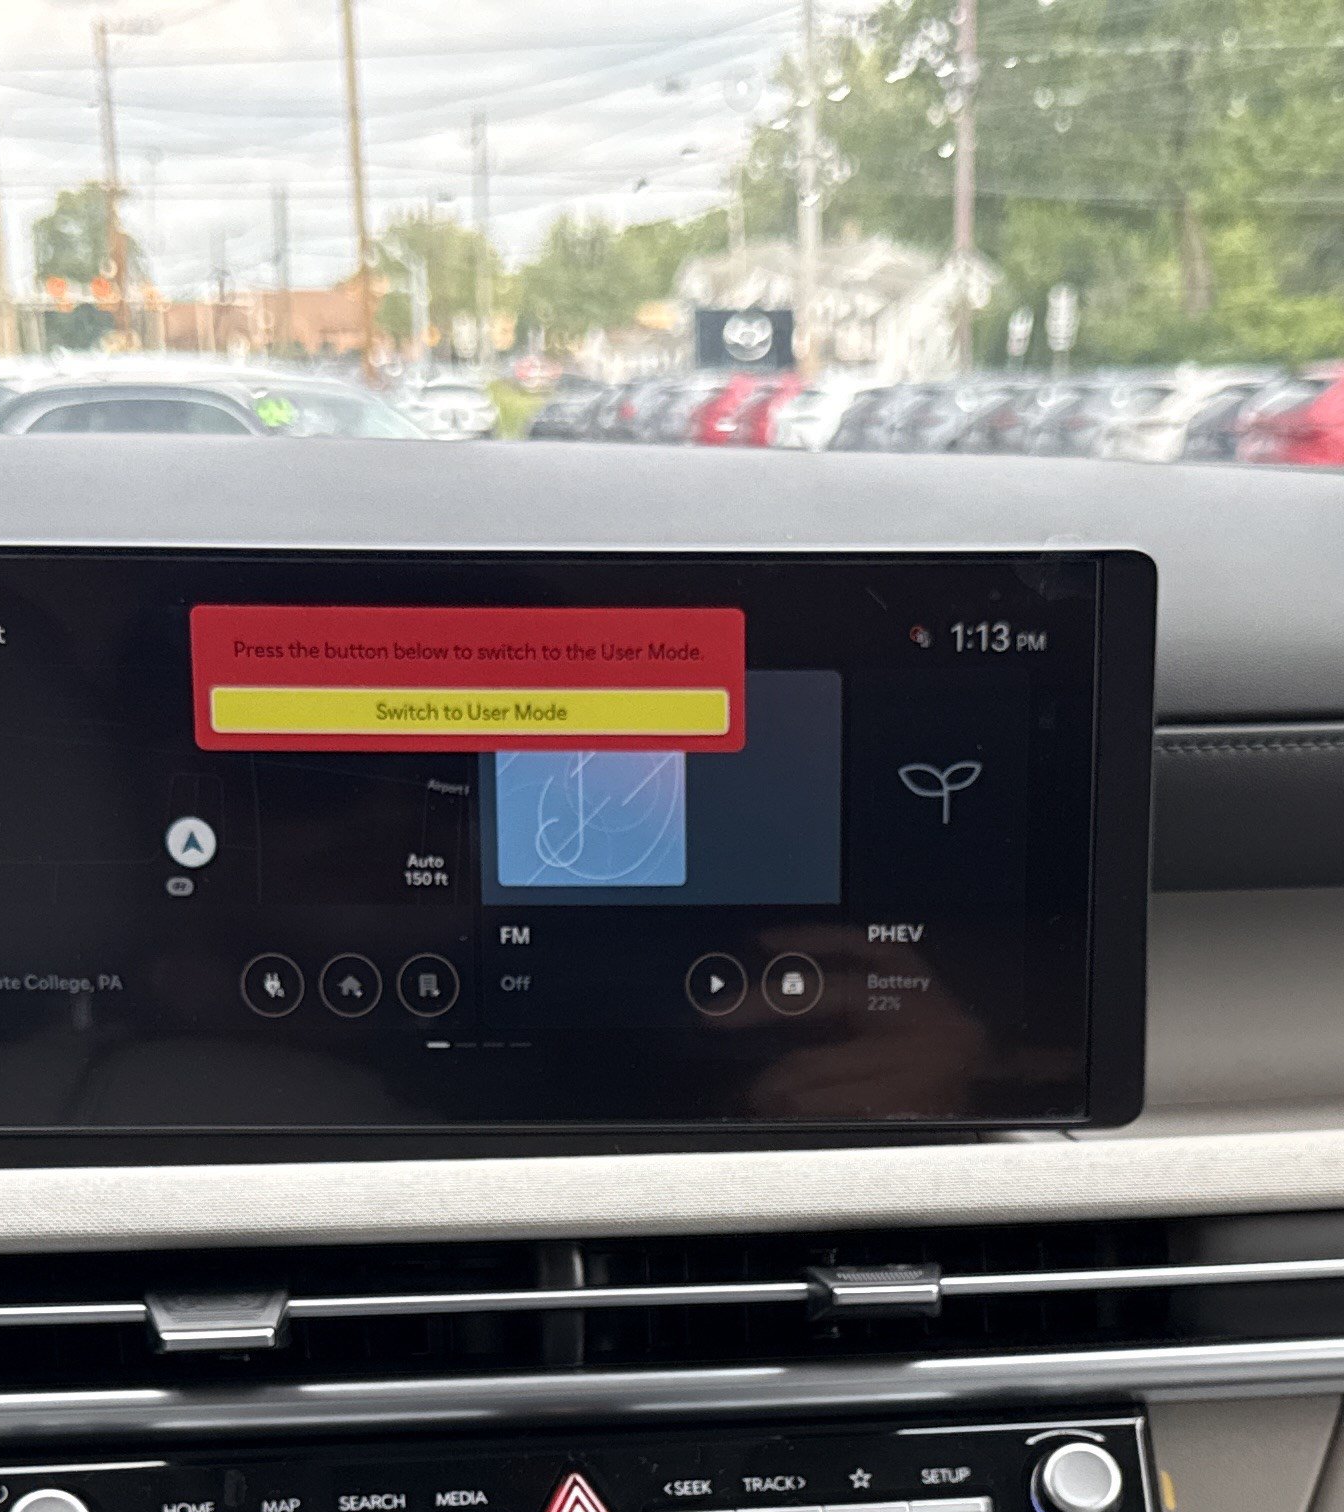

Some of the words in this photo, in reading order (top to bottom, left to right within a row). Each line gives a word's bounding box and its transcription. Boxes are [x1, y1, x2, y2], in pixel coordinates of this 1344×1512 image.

[950, 622, 1010, 652] 1:13
[1016, 631, 1047, 652] PM
[233, 641, 283, 659] Press
[287, 641, 320, 659] the
[324, 642, 389, 660] button
[394, 642, 448, 660] below
[453, 644, 473, 661] to
[476, 643, 536, 661] switch
[541, 643, 561, 661] to
[565, 643, 596, 661] the
[600, 644, 643, 661] User
[376, 702, 439, 721] Switch
[442, 704, 463, 721] to
[467, 703, 508, 721] User
[513, 703, 567, 721] Mode
[407, 853, 445, 869] Auto
[404, 871, 433, 886] 150
[434, 871, 449, 886] ft
[500, 926, 530, 944] FM
[867, 924, 923, 943] PHEV
[98, 974, 123, 991] PA
[500, 974, 530, 992] Off
[867, 973, 930, 993] Battery
[921, 1467, 971, 1485] SETUP
[338, 1494, 407, 1512] SEARCH
[435, 1490, 488, 1508] MEDIA
